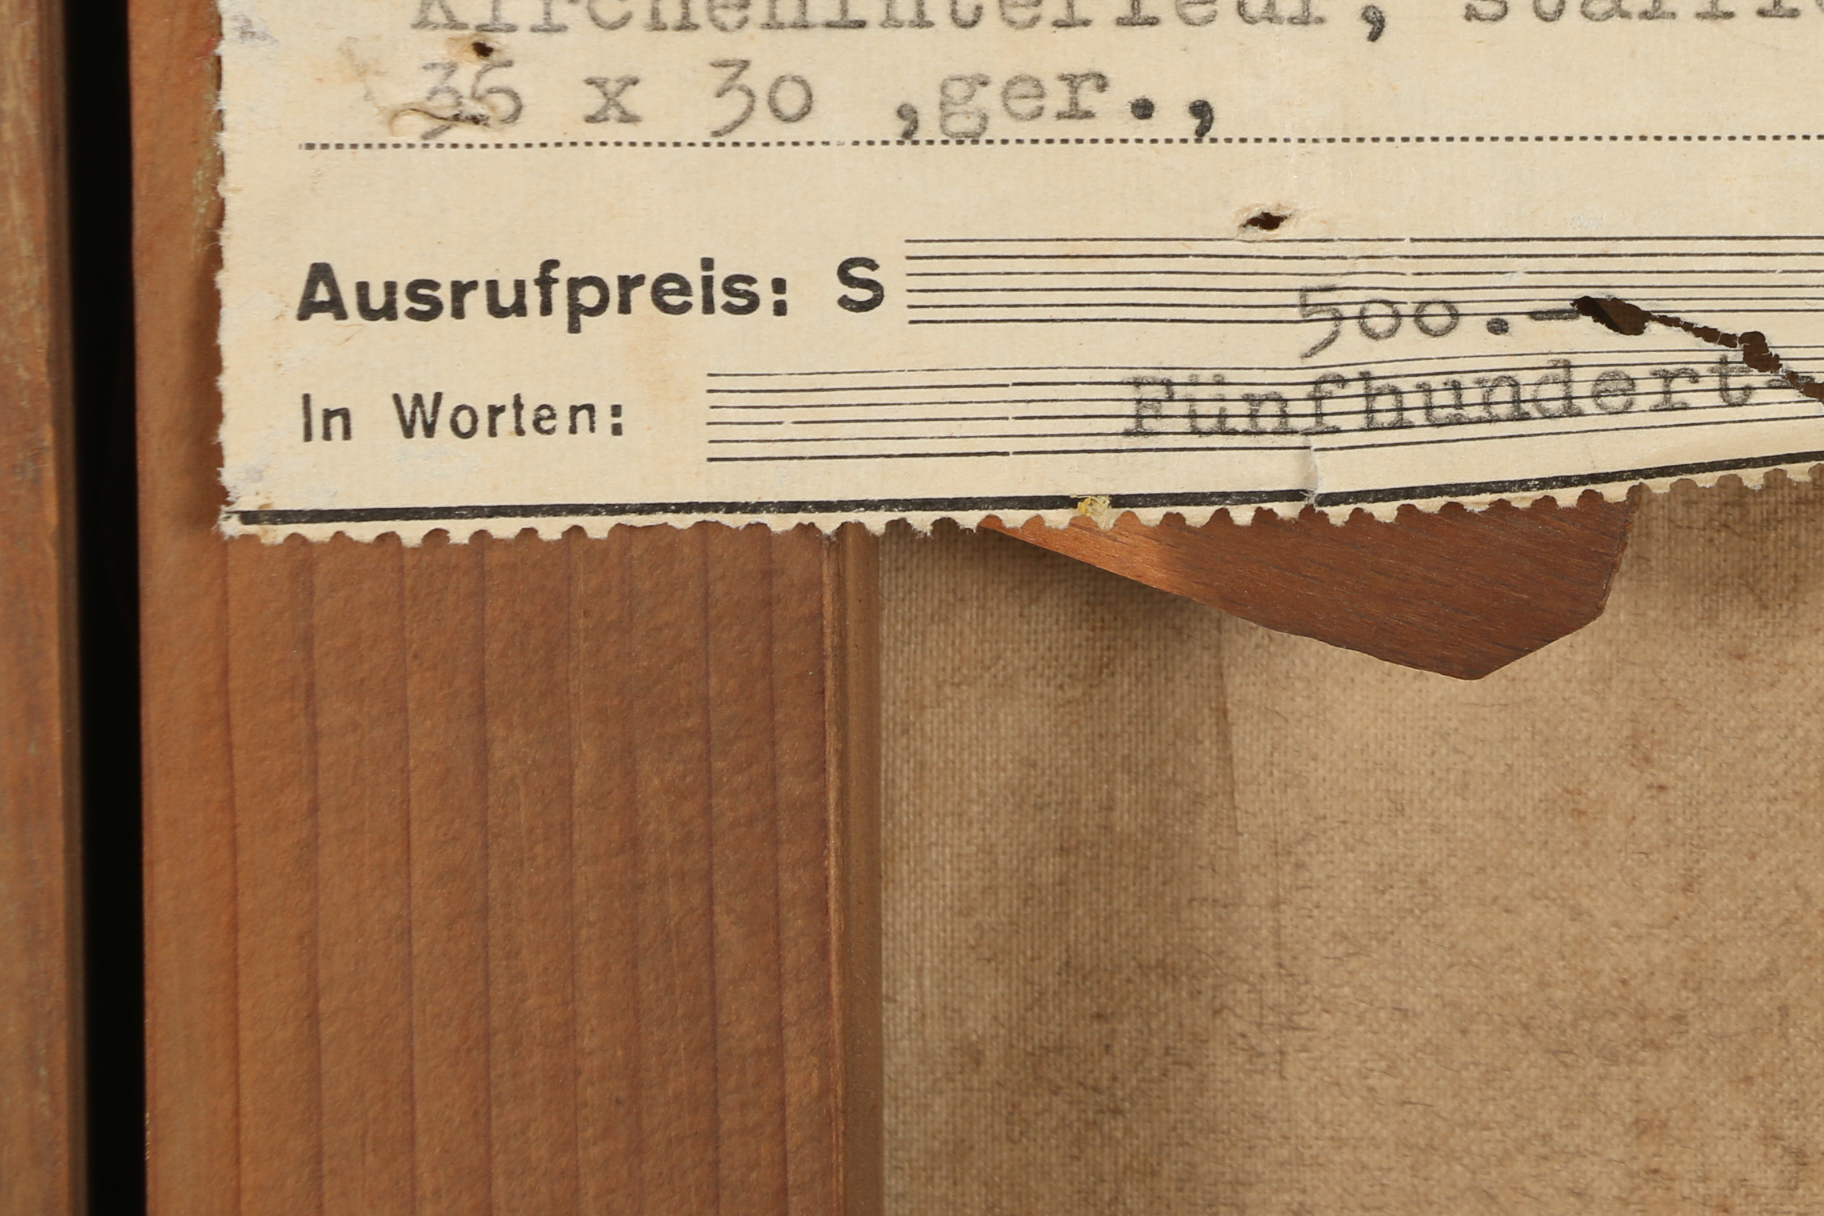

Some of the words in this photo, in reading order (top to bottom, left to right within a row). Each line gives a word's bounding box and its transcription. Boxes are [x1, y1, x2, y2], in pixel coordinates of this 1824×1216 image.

[582, 74, 642, 124] x
[709, 58, 814, 138] 30
[296, 257, 790, 333] Ausrufpreis:
[836, 256, 887, 313] S
[300, 392, 353, 443] In
[397, 390, 627, 440] Worten:
